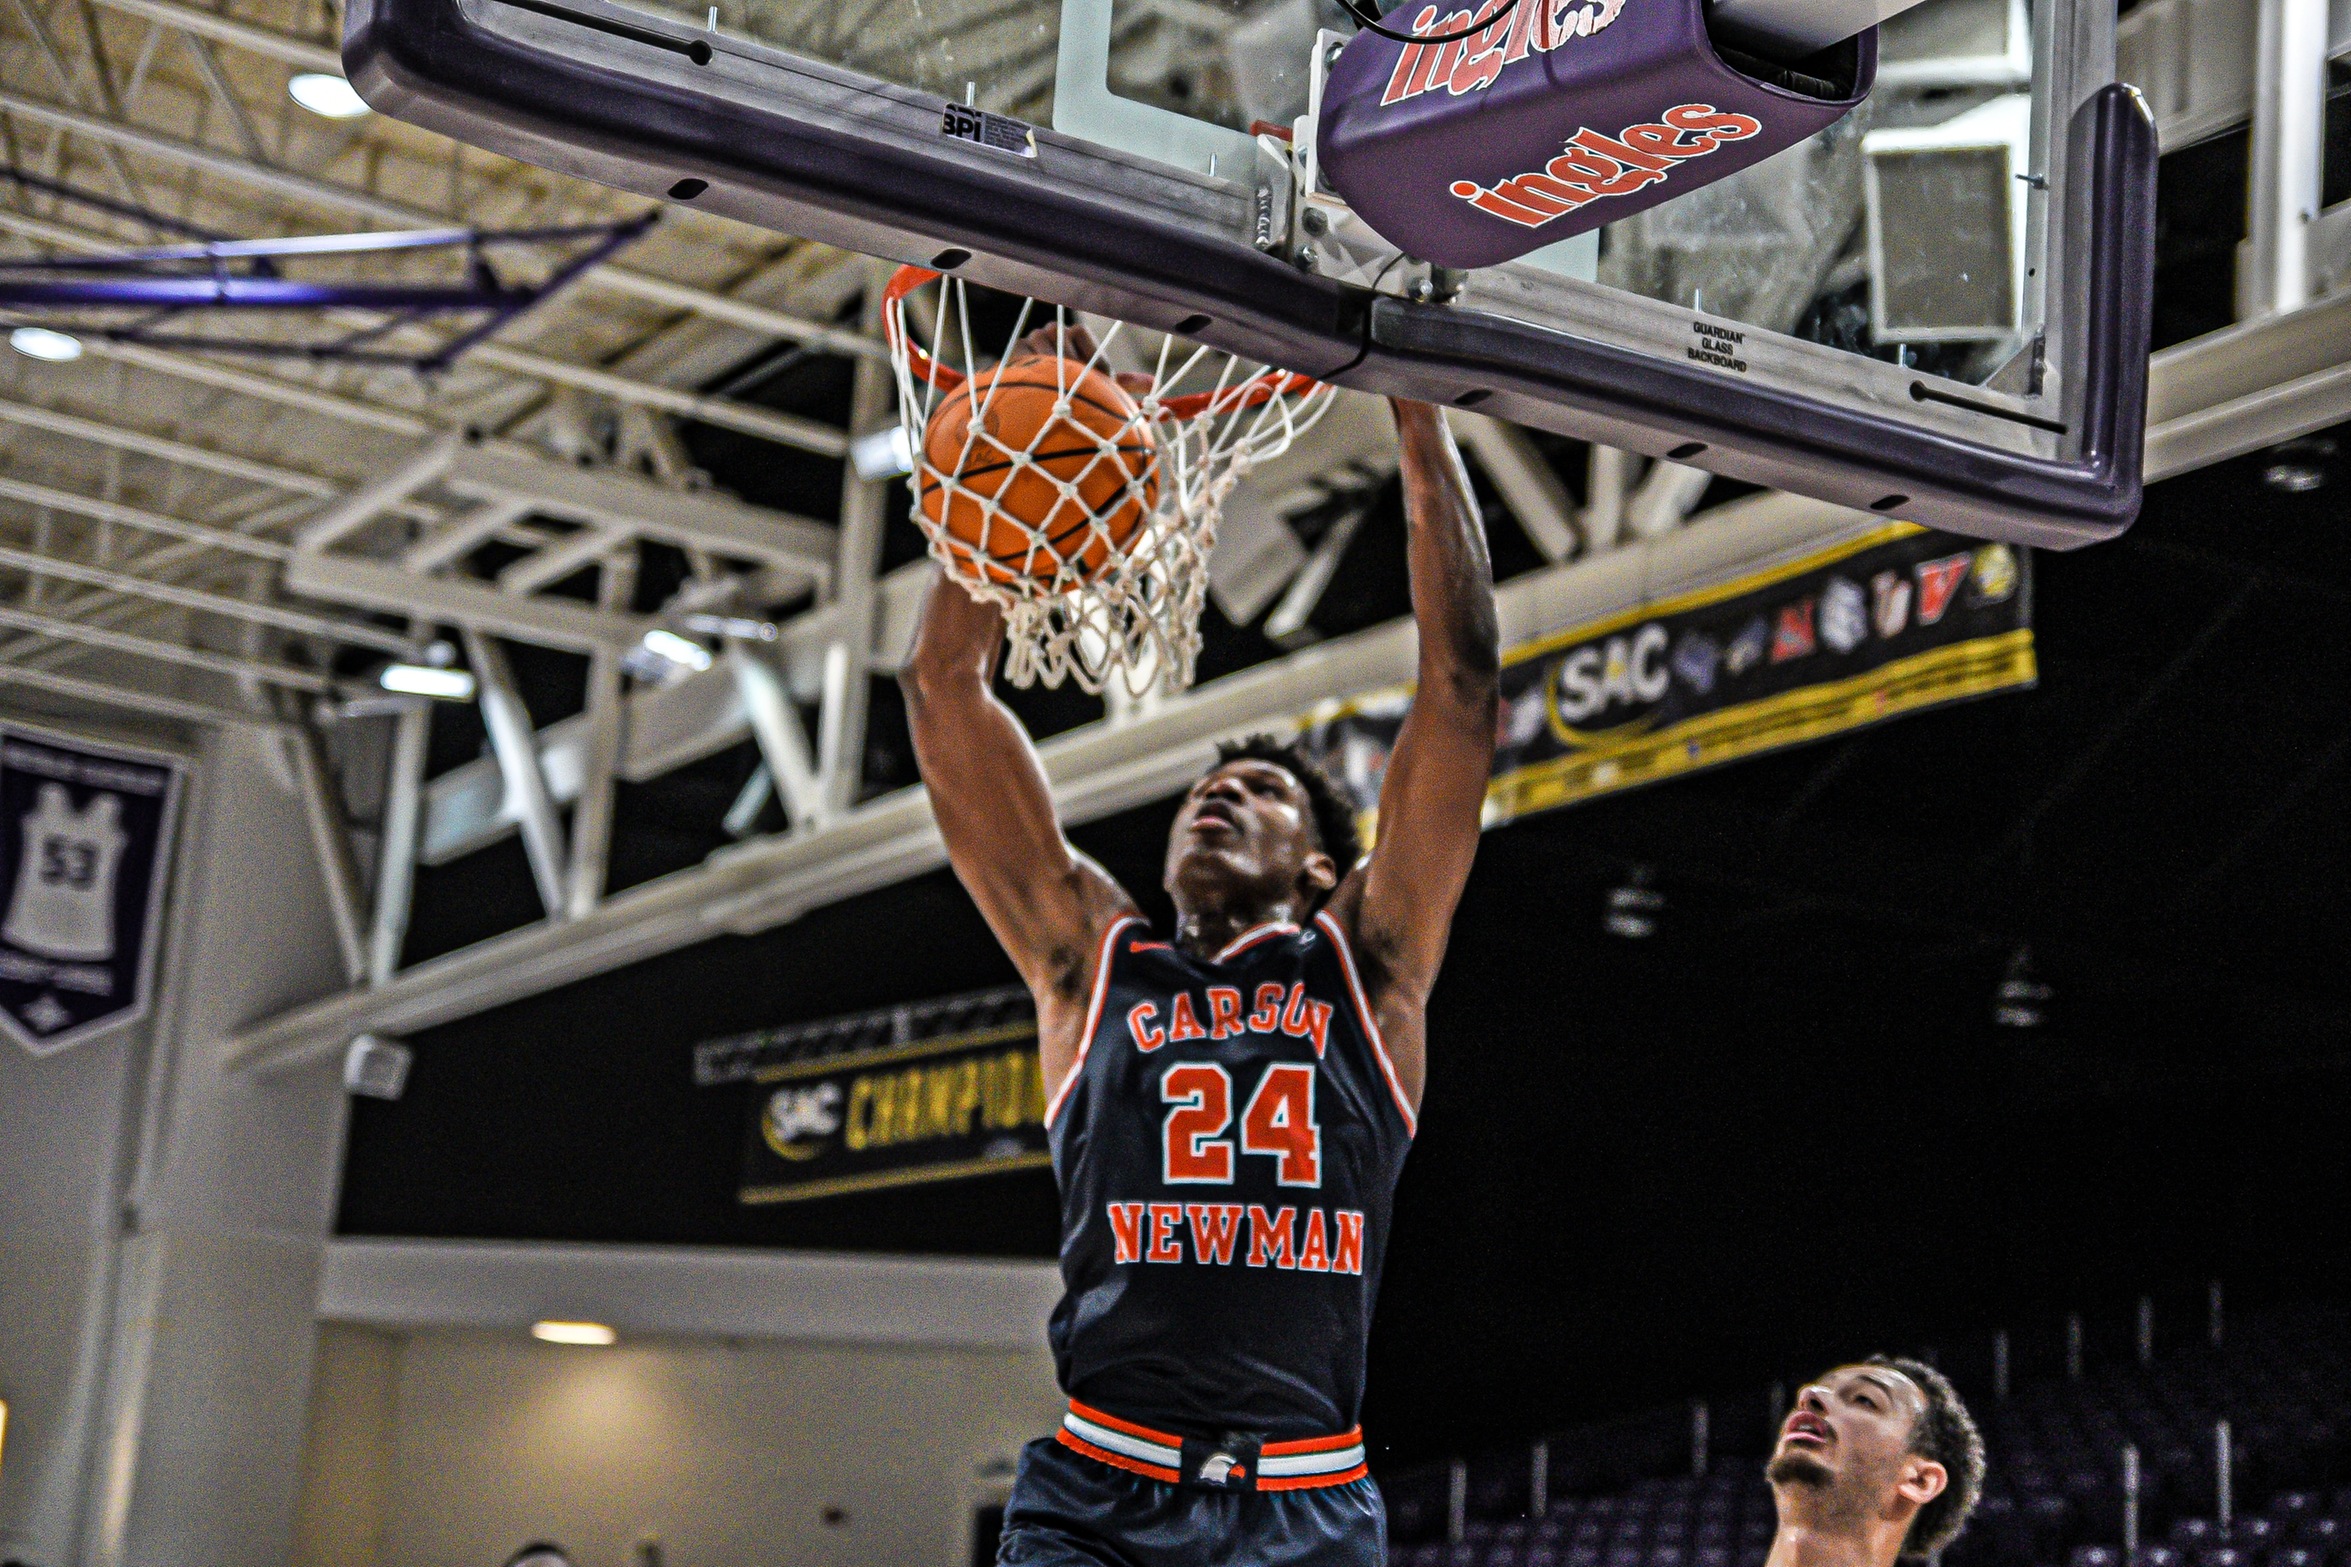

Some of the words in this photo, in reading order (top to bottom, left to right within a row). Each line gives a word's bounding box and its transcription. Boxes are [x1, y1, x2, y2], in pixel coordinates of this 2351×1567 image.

[1449, 103, 1763, 228] ingles
[1687, 347, 1747, 373] BACKBOARD
[1693, 321, 1743, 345] GUARDIAN
[1701, 337, 1734, 356] GLASS
[1559, 622, 1669, 722] SAC
[1160, 1062, 1323, 1190] 24
[1106, 1202, 1365, 1276] NEWMAN
